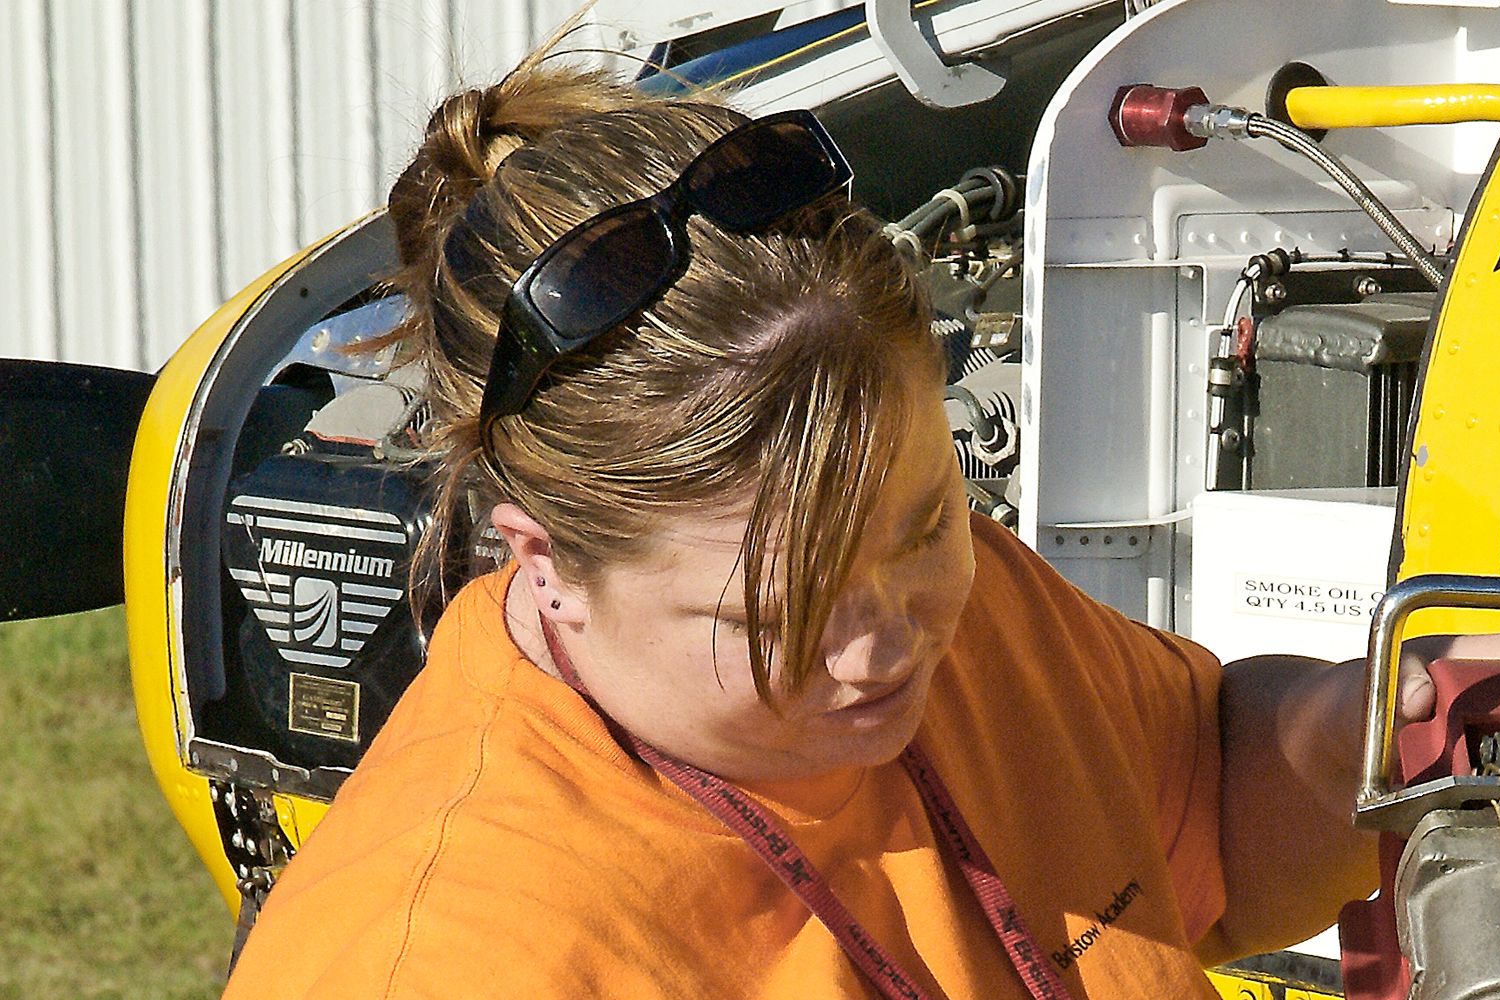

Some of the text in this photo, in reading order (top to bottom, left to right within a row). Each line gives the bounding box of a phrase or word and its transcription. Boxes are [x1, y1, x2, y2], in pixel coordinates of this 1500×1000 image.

[259, 537, 395, 578] Millennium
[1244, 579, 1364, 602] SMOKE OIL
[1246, 595, 1288, 610] QTY
[1294, 601, 1326, 614] 4.5
[1333, 603, 1362, 617] US
[1051, 879, 1145, 970] Bristow Academy
